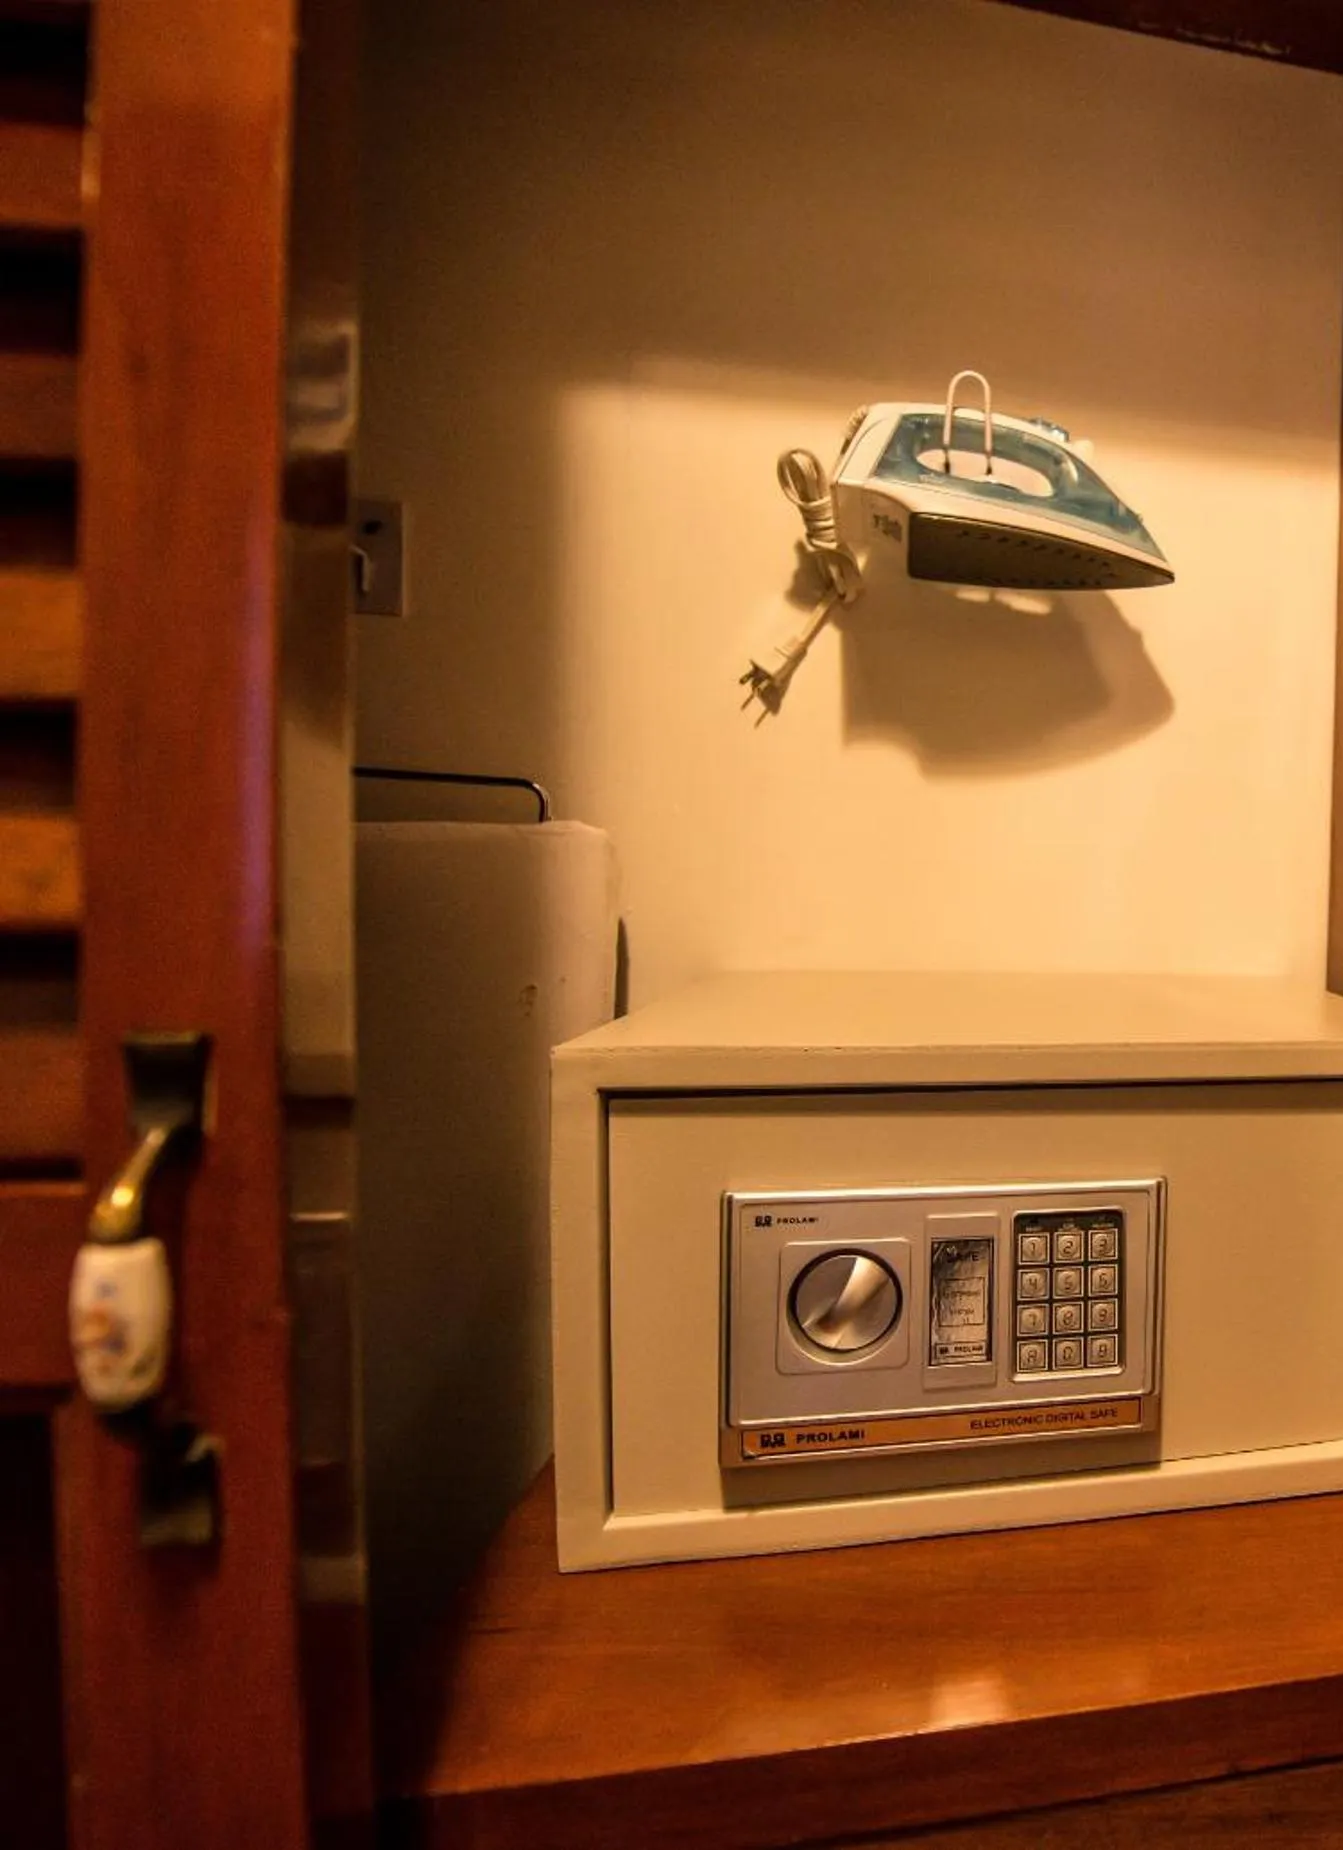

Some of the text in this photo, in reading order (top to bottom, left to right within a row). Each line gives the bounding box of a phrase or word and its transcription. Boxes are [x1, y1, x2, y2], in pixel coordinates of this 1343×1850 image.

[1062, 1240, 1073, 1254] 2
[1098, 1238, 1108, 1253] 3
[1028, 1277, 1038, 1291] 4
[1098, 1272, 1108, 1290] 6
[1062, 1310, 1073, 1326] 8
[1098, 1308, 1108, 1322] 9
[1062, 1345, 1073, 1361] 0
[969, 1407, 1119, 1429] ELECTRONIC DIGITAL SAFE
[796, 1429, 866, 1444] PROLAMI
